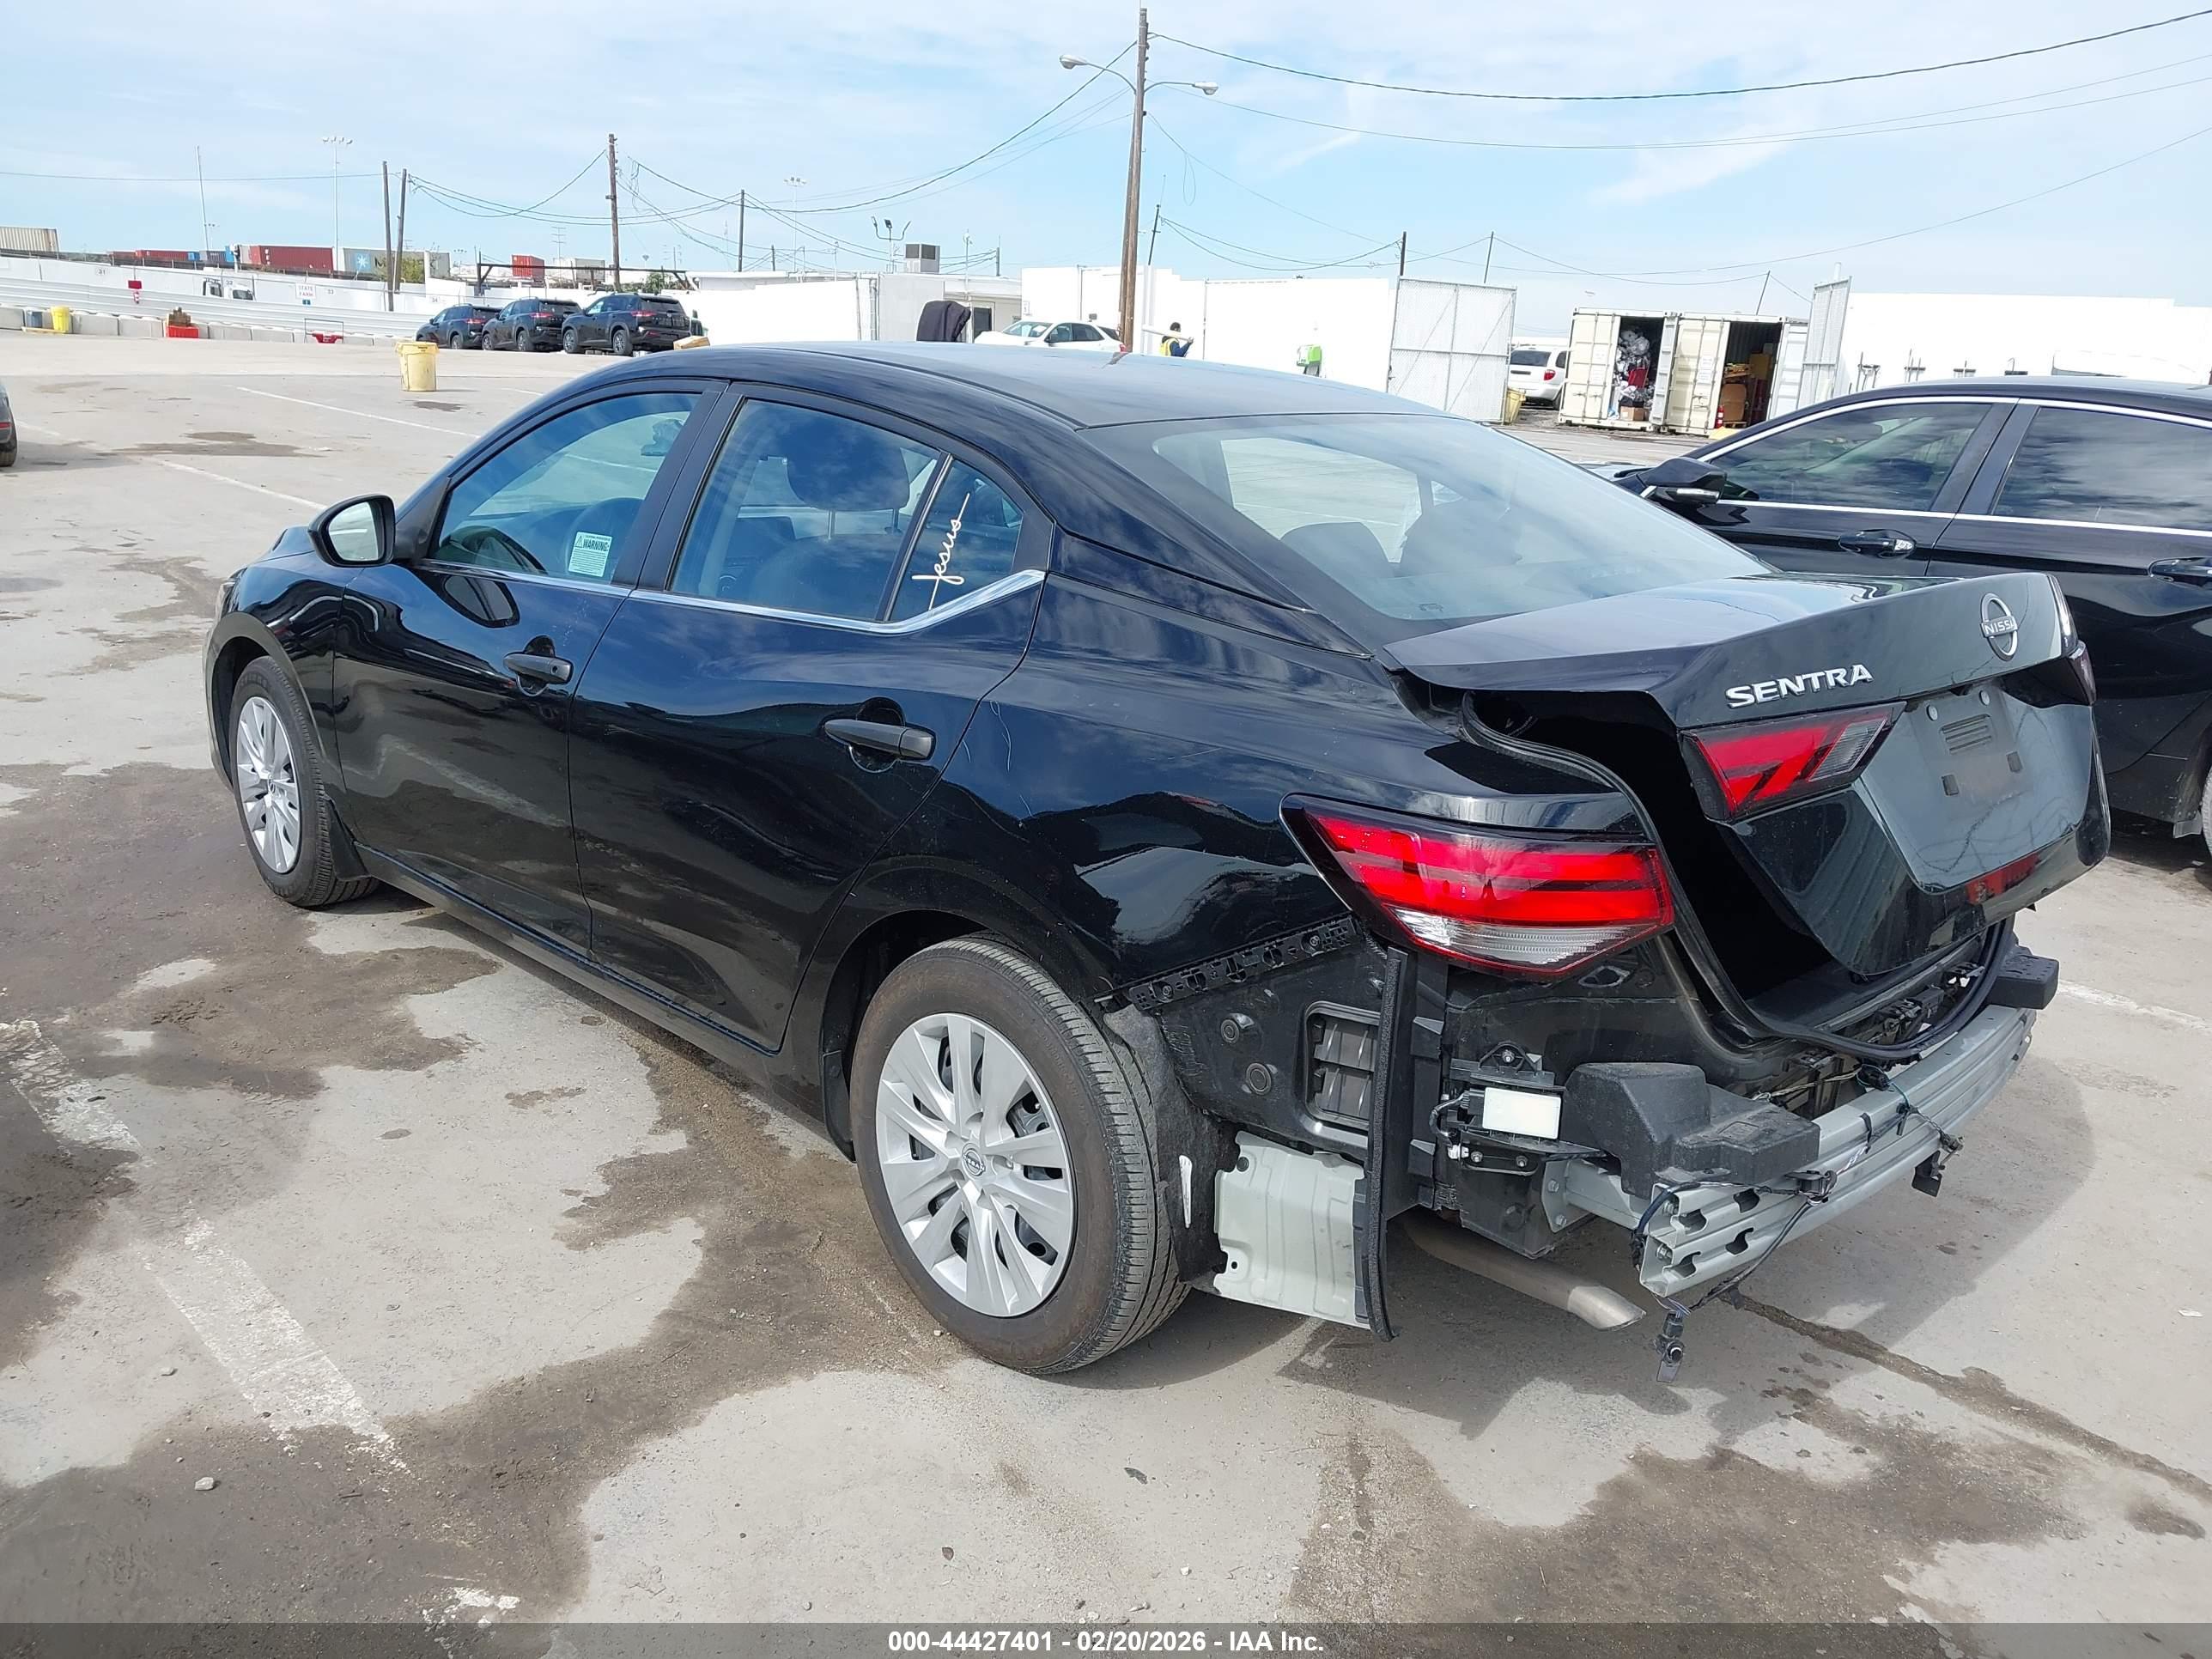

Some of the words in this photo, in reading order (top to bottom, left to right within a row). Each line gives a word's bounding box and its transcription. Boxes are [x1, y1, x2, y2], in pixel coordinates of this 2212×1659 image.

[1984, 618, 2015, 635] NISS
[1725, 664, 1874, 708] SENTRA
[963, 1154, 985, 1171] NSSAN
